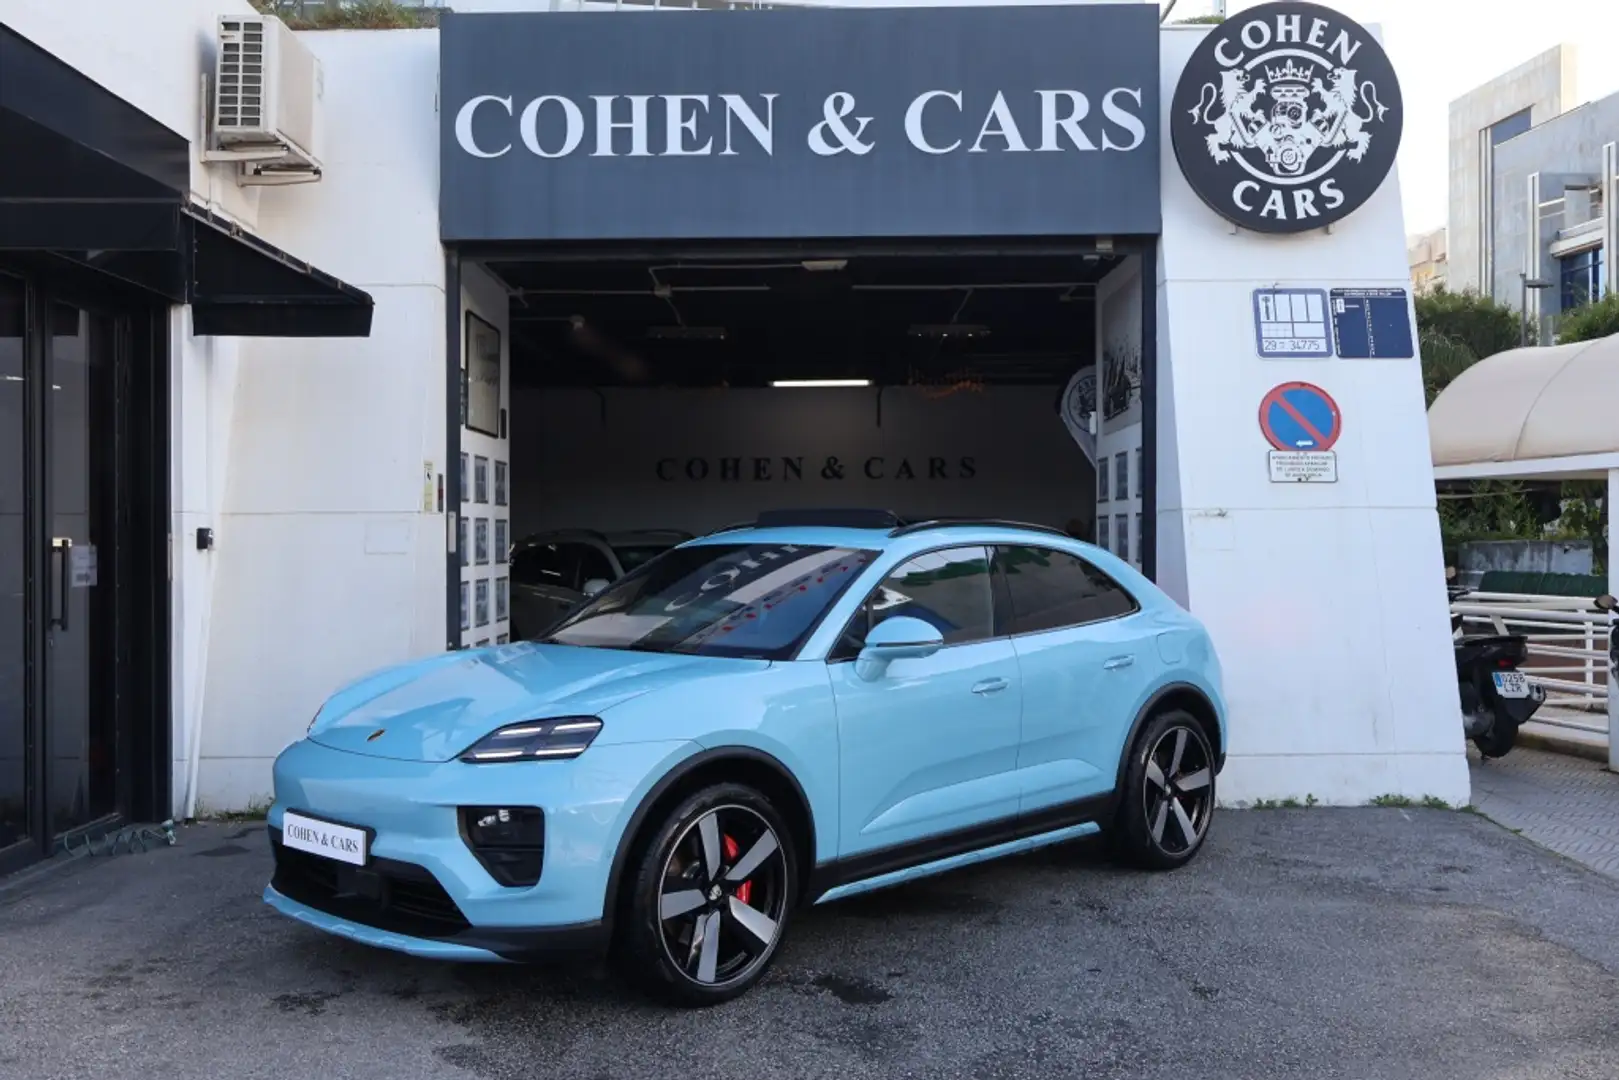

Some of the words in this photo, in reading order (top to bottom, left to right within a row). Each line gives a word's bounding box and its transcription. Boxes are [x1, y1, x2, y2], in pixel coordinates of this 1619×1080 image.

[1214, 14, 1363, 67] COHEN
[455, 93, 779, 158] COHEN
[807, 91, 875, 156] &
[904, 87, 1147, 154] CARS
[1232, 178, 1345, 220] CARS
[655, 456, 804, 482] COHEN
[820, 455, 845, 480] &
[864, 456, 977, 480] CARS
[287, 823, 319, 845] COHEN
[321, 832, 329, 848] &
[330, 835, 359, 853] CARS
